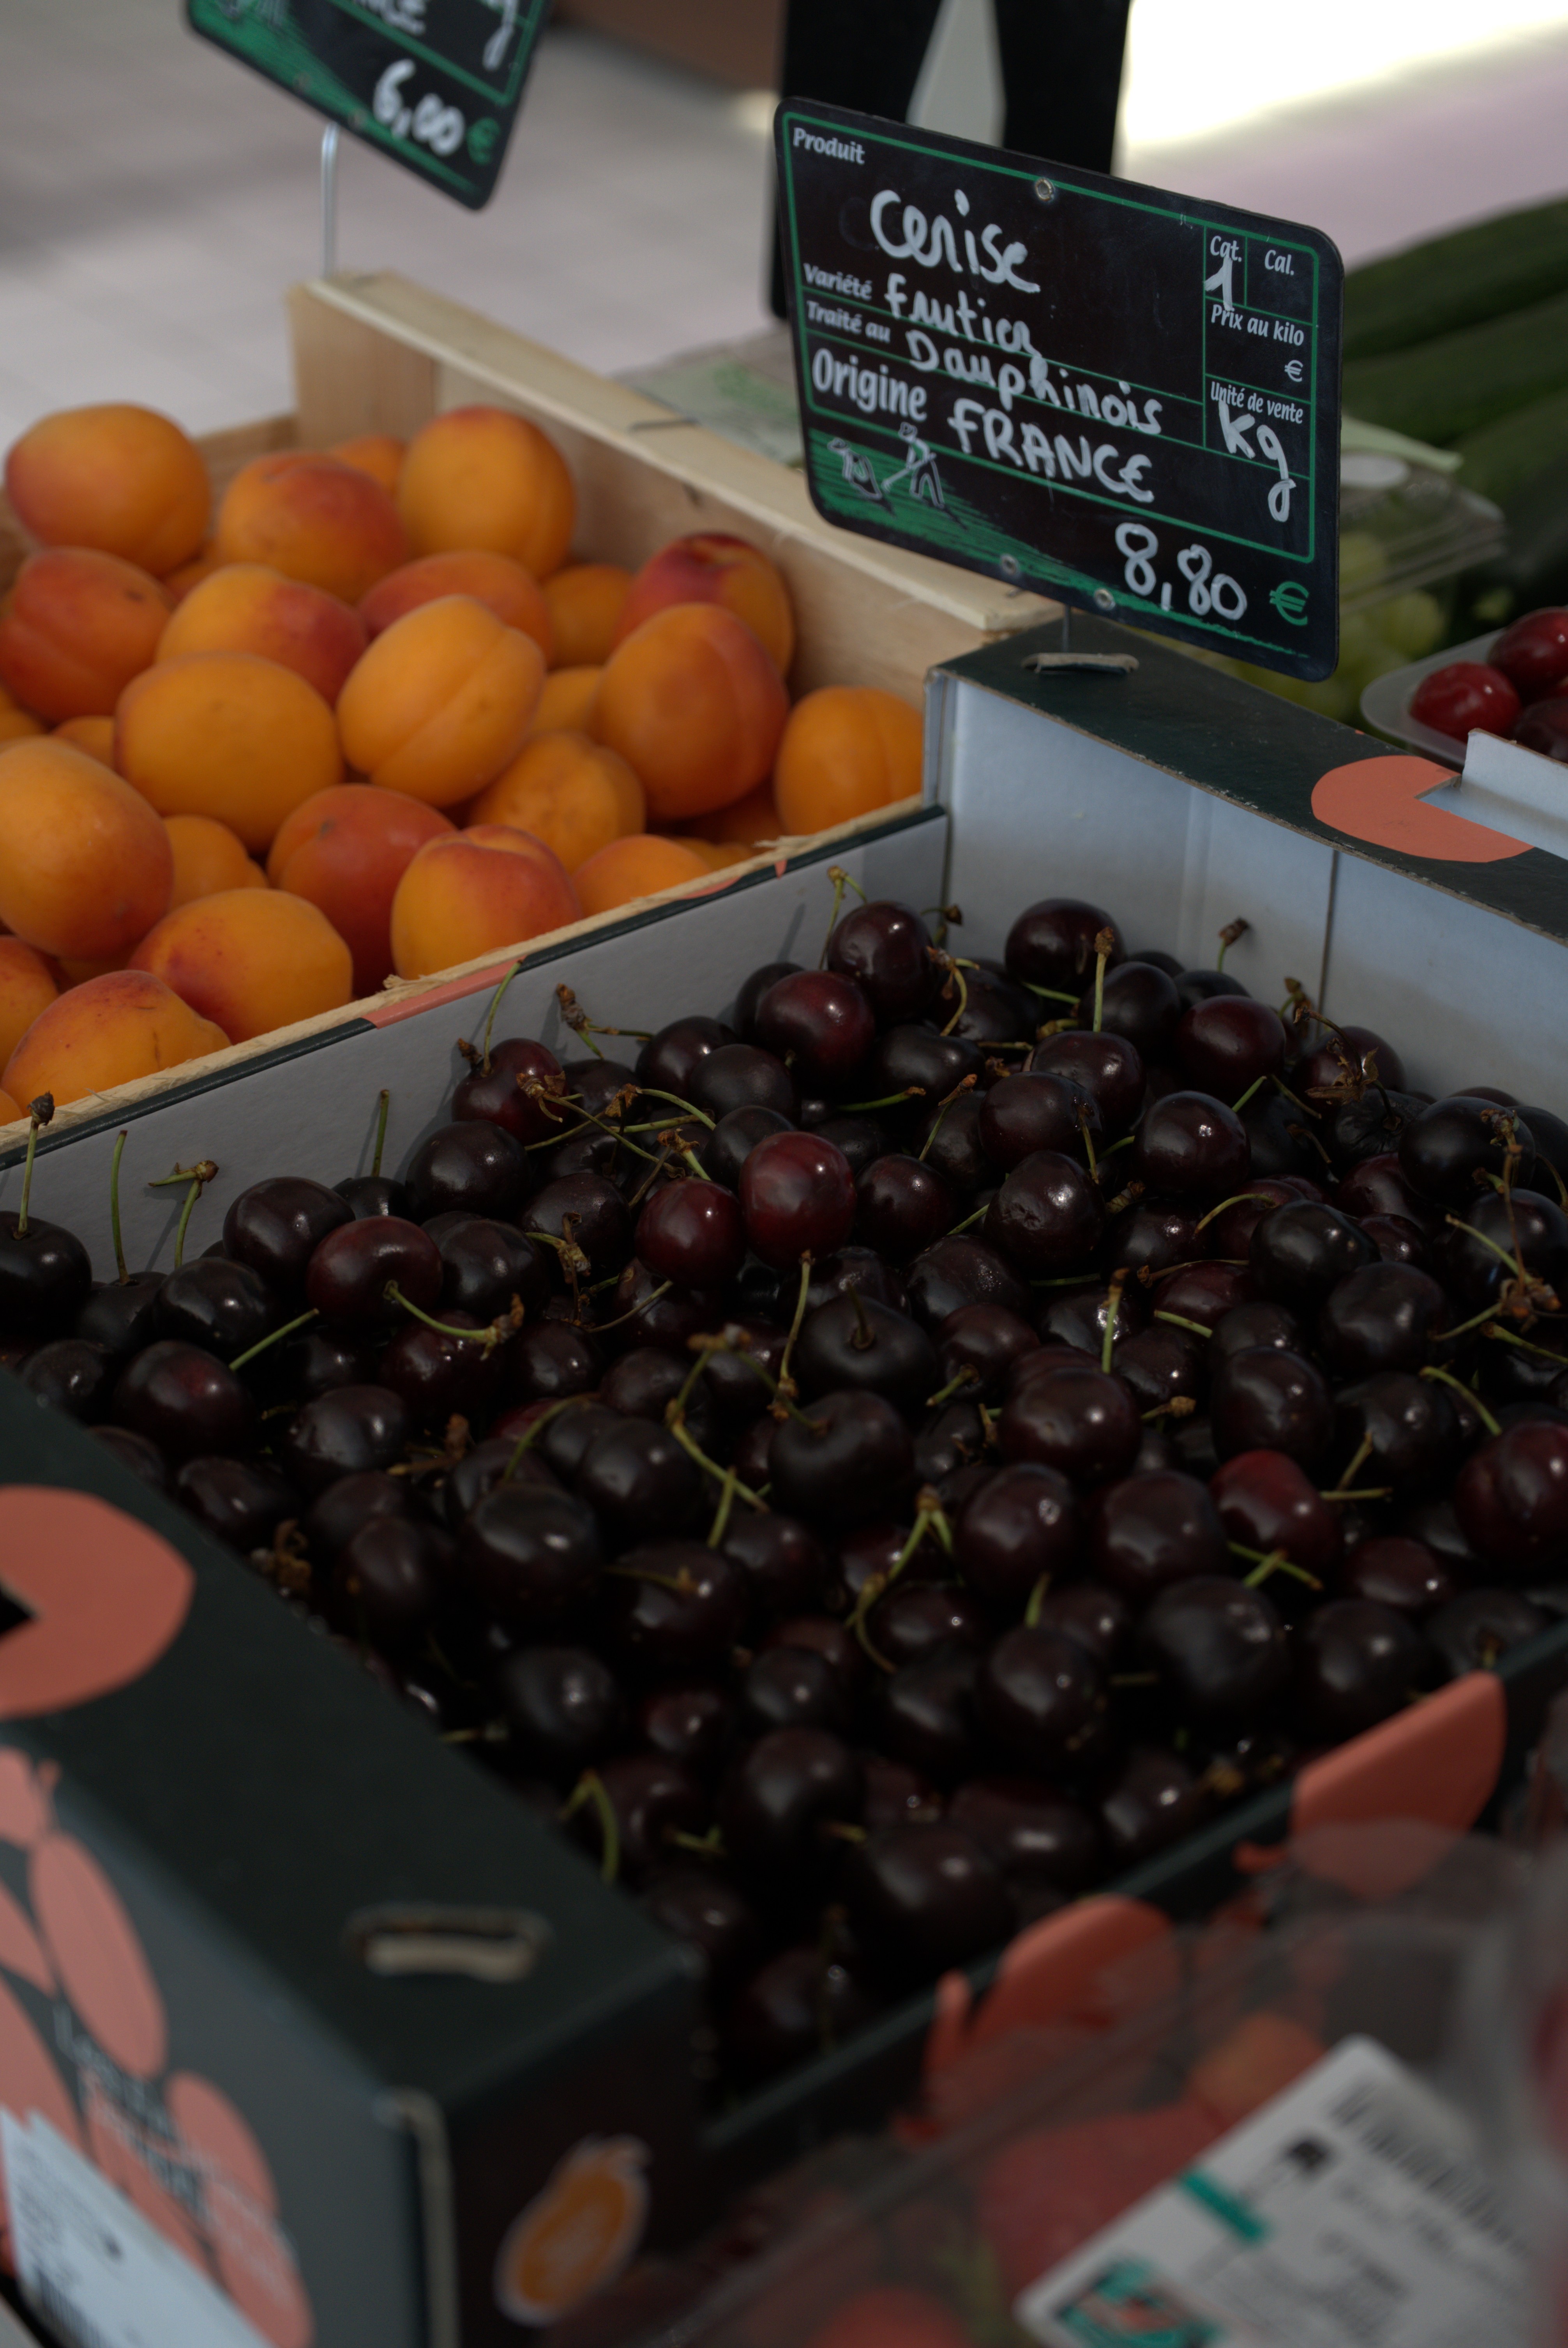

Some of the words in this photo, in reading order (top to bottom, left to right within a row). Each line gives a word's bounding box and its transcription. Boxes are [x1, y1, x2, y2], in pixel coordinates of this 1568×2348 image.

[793, 127, 865, 165] Produit
[870, 189, 1041, 293] Cerise
[1210, 235, 1242, 262] Cat.
[1264, 249, 1294, 276] Cal.
[803, 263, 872, 301] Variété
[1203, 256, 1233, 311] 1
[807, 300, 862, 332] Traité
[865, 321, 891, 343] au
[1211, 304, 1242, 331] Prix
[1247, 318, 1268, 338] au
[1273, 321, 1304, 346] kilo
[1210, 381, 1245, 408] Unité
[1248, 394, 1264, 413] de
[1267, 401, 1303, 424] vente
[812, 348, 928, 421] Origine
[947, 398, 1155, 503] FRANCE
[1115, 522, 1247, 620] 8,80
